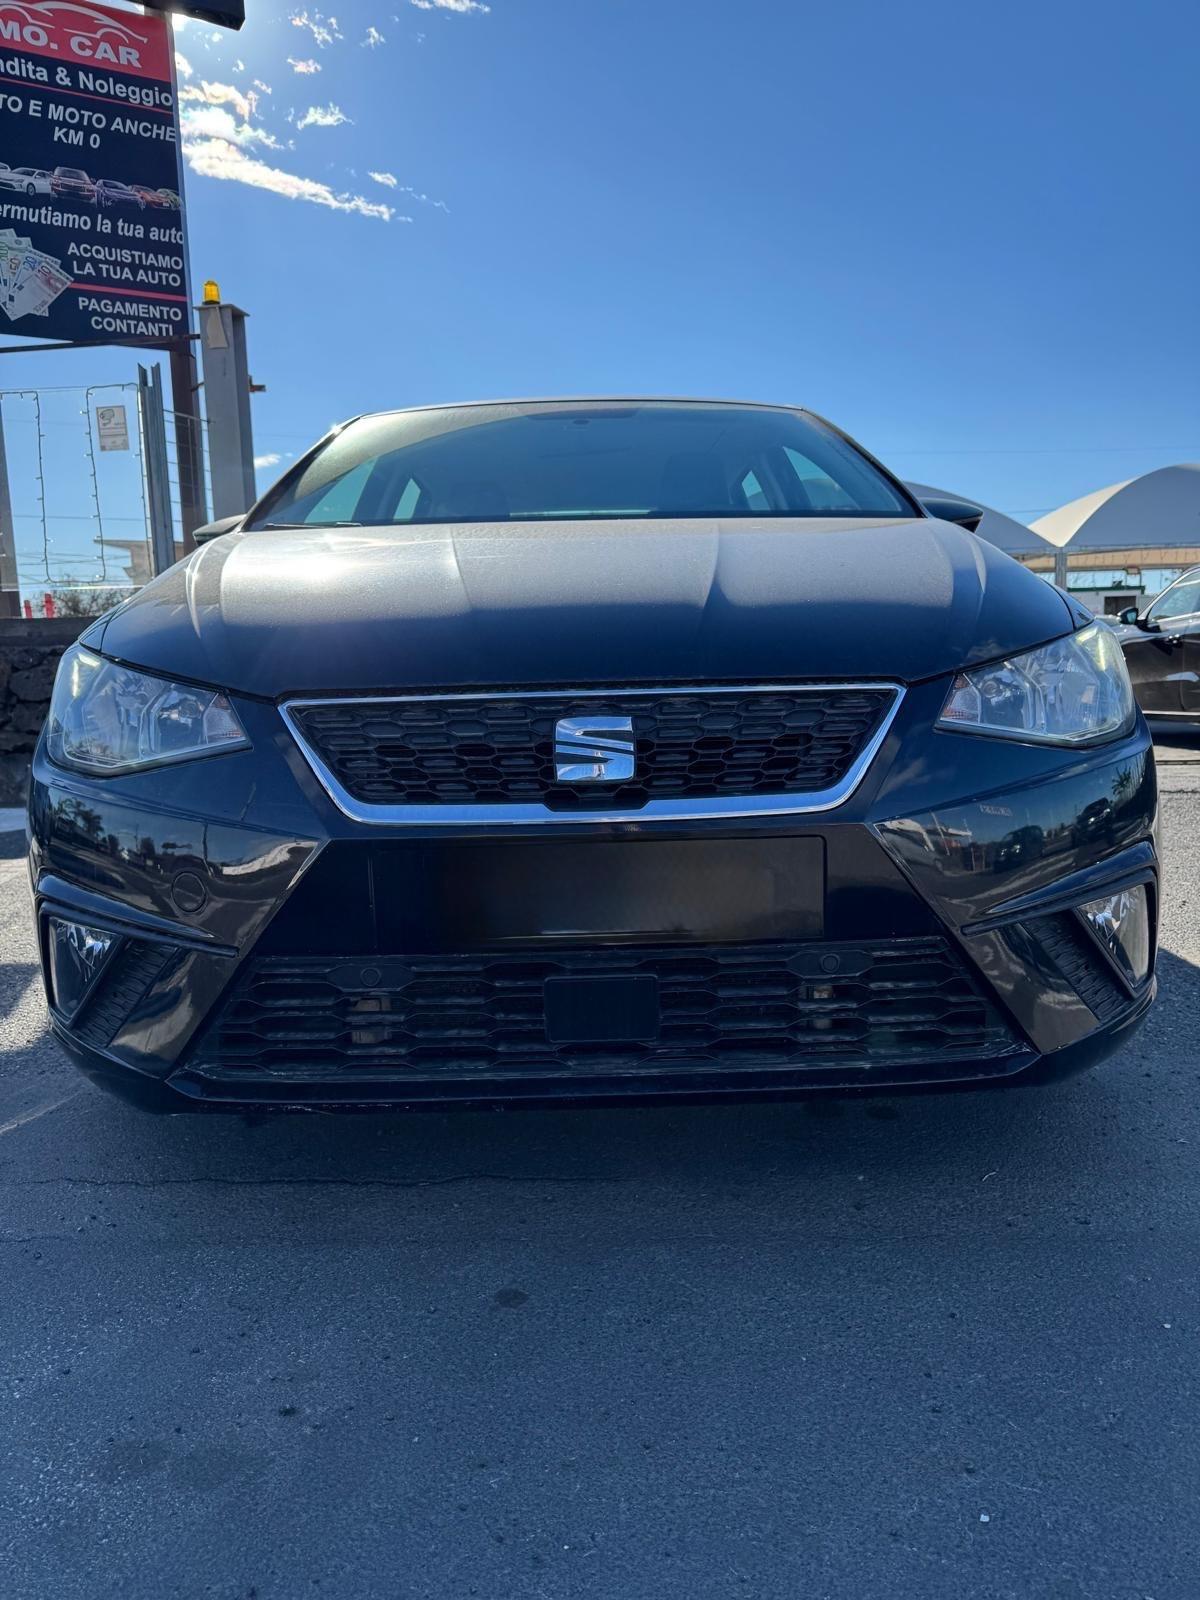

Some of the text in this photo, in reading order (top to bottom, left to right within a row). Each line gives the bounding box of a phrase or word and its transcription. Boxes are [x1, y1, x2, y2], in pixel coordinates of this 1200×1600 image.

[71, 37, 141, 67] CAR
[55, 67, 71, 86] &
[79, 72, 172, 106] Noleggio
[29, 101, 42, 117] E
[48, 104, 106, 128] MOTO
[111, 118, 176, 141] ANCHE
[53, 127, 83, 145] KM
[0, 204, 184, 244] rmutiamo la tua auto
[67, 243, 183, 270] ACQUISTIAMO
[73, 262, 180, 287] LA TUA AUTO
[79, 297, 181, 321] PAGAMENTO
[91, 316, 173, 337] CONTANTI
